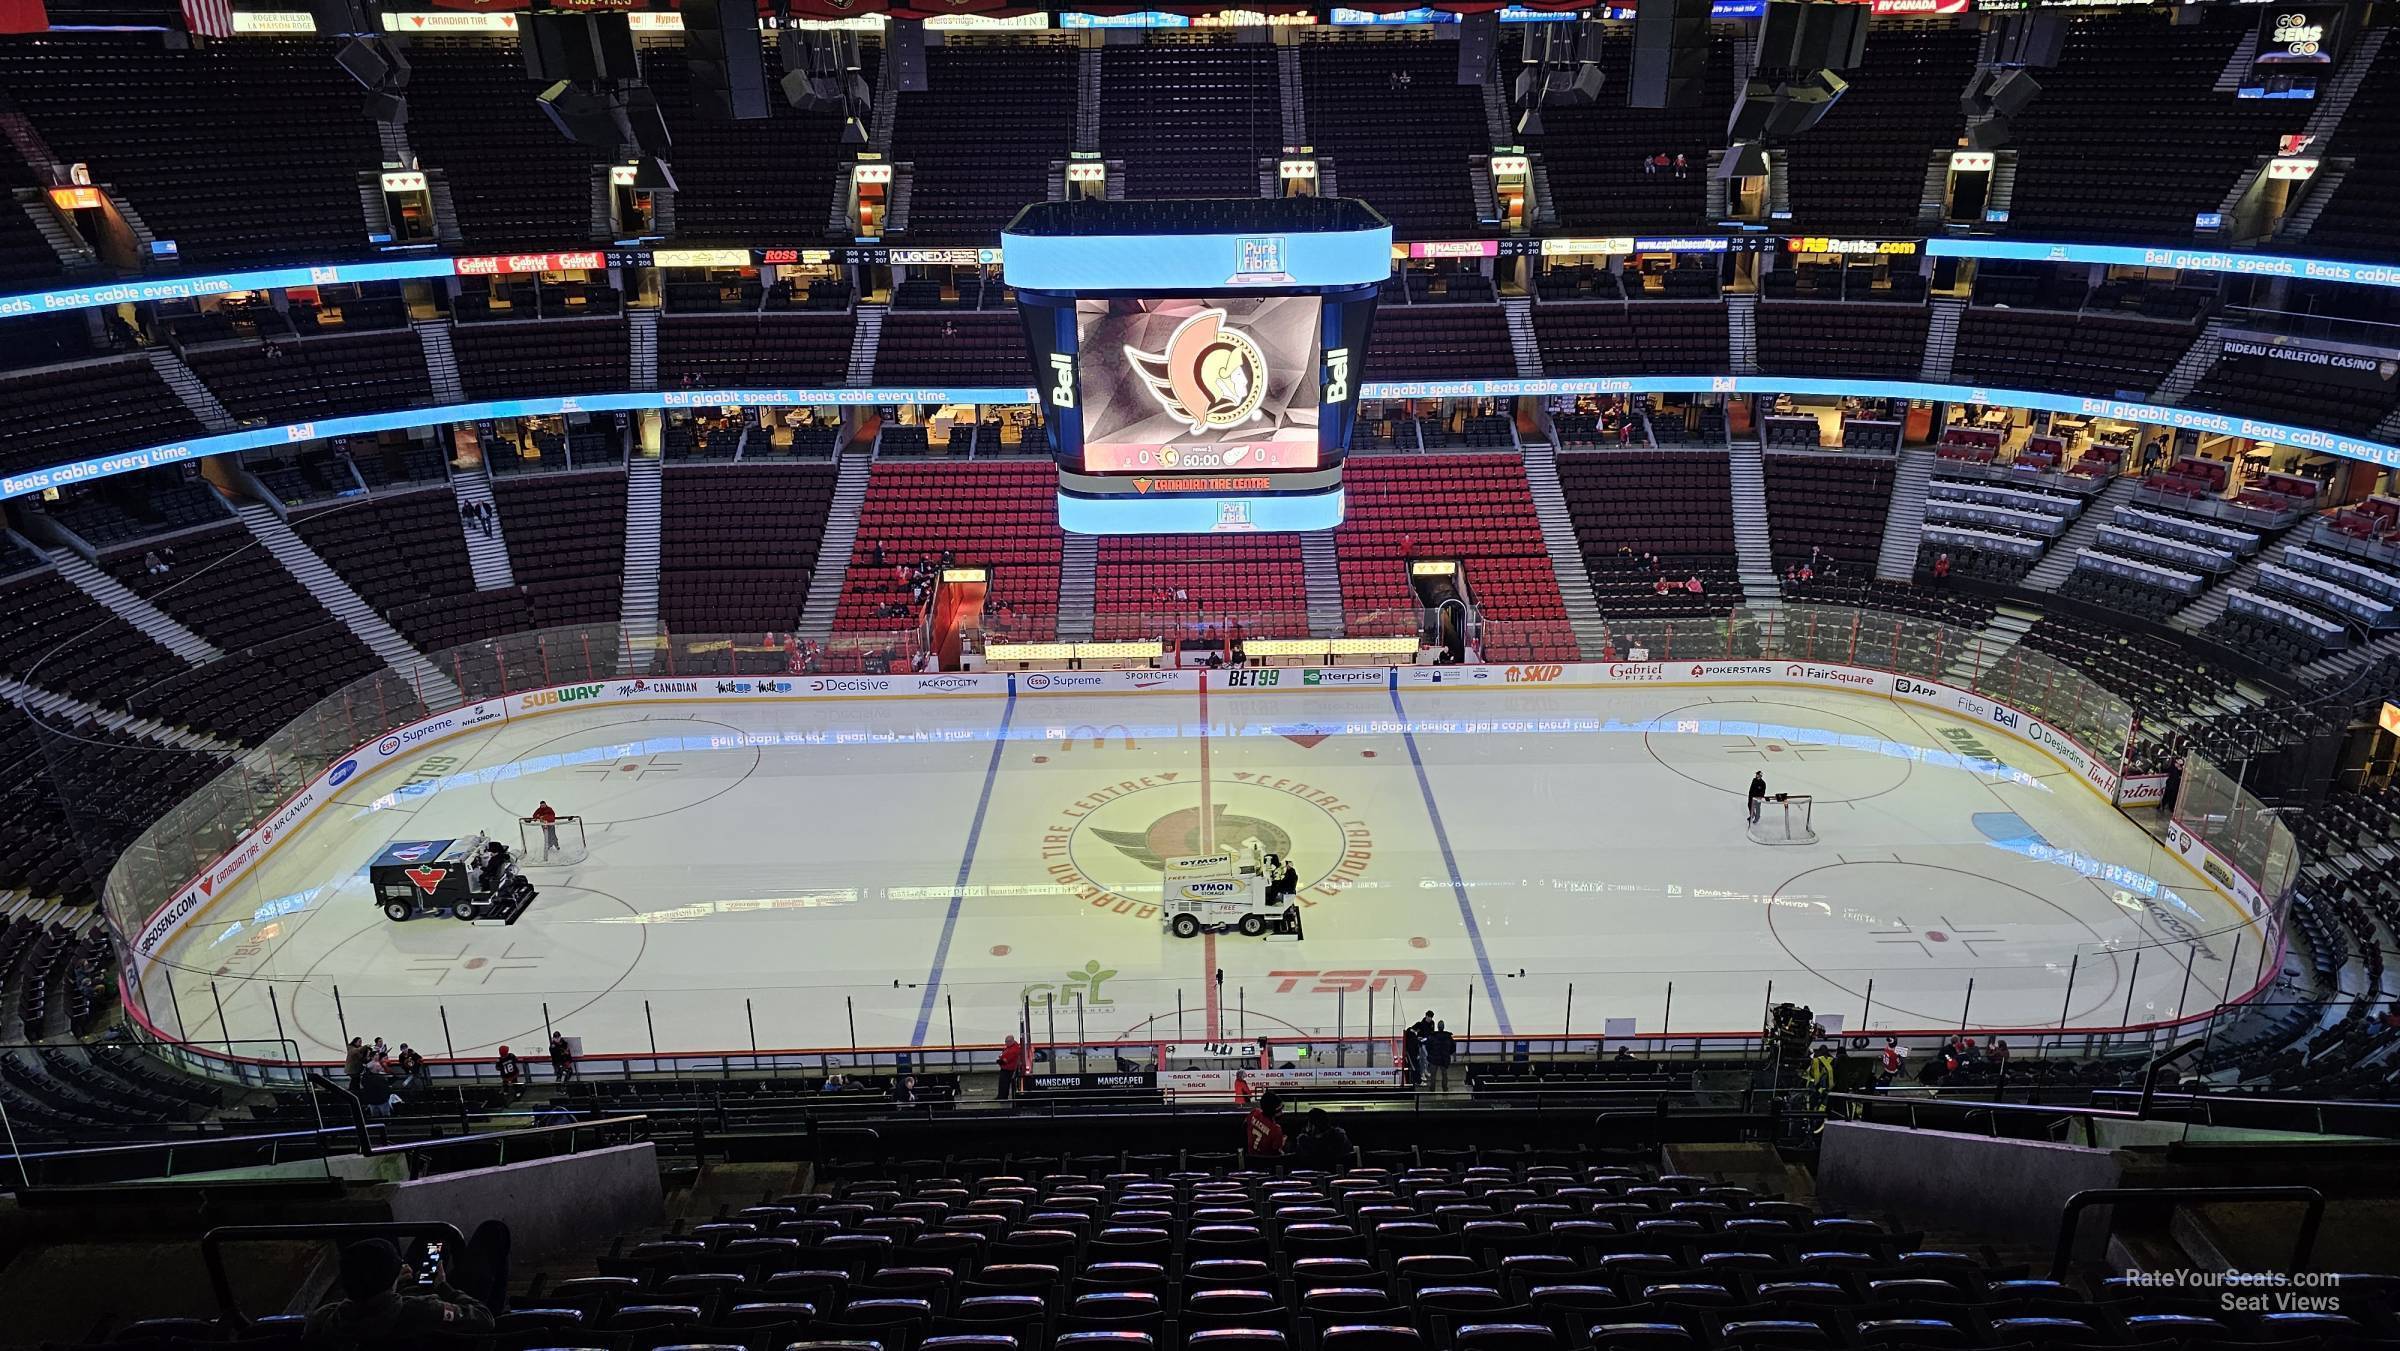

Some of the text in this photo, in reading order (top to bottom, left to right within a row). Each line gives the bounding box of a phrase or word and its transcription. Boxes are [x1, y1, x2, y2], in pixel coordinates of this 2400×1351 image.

[1897, 0, 1937, 10] CANADA
[253, 14, 311, 22] ROGER NEILSON
[259, 22, 290, 30] MAISON
[428, 16, 488, 26] CANADIAN TIRE
[2276, 14, 2306, 29] GO
[2273, 26, 2323, 42] SENS
[2288, 41, 2319, 56] GO
[765, 250, 799, 261] ROSS
[1245, 241, 1277, 255] Pure
[1436, 243, 1483, 253] MAGENTA
[458, 258, 496, 271] Gabriel
[509, 255, 548, 269] Gabriel
[558, 253, 597, 267] Gabriel
[891, 250, 943, 264] ALIGNED
[2145, 250, 2400, 284] Bell gigabit speeds. Beats cable
[311, 267, 338, 284] Bell
[44, 278, 233, 308] Beats cable every time.
[2224, 342, 2377, 371] RIDEAU CARLETON CASINO
[1051, 353, 1074, 409] Bell
[1326, 347, 1348, 405] Bell
[1381, 383, 1426, 398] gigabit
[1430, 382, 1478, 396] speeds.
[1485, 382, 1521, 393] Beats
[1524, 381, 1560, 392] cable
[1561, 381, 1597, 393] every
[1601, 378, 1632, 391] time.
[1712, 377, 1737, 392] Bell
[665, 389, 950, 407] Bell gigabit speeds. Beats cable every time.
[287, 422, 315, 441] Bell
[2082, 399, 2384, 464] Bell gigabit speeds. Beats cable every
[1138, 449, 1150, 465] 0
[1183, 454, 1220, 467] 60:00
[1254, 448, 1266, 462] 0
[3, 445, 192, 494] Beats cable every time.
[1154, 477, 1271, 491] CANADIAN TIRE CENTRE
[1228, 669, 1280, 687] BET99
[1304, 670, 1382, 683] enterprise
[1521, 664, 1564, 682] SKIP
[1609, 663, 1664, 678] Gabriel
[1706, 666, 1772, 674] POKERSTARS
[1807, 668, 1875, 685] FairSquare
[617, 681, 698, 698] Molson CANADIAN
[826, 679, 889, 692] Decisive
[918, 679, 979, 690] JACKPOTCITY
[1053, 676, 1101, 688] Supreme
[521, 684, 605, 710] SUBWAY
[1957, 696, 1984, 715] Fibe
[462, 713, 501, 727] NHLSHOP.CA
[1993, 706, 2019, 729] Bell
[402, 719, 452, 743] Supreme
[2044, 732, 2085, 769] Desjardins
[2087, 760, 2104, 787] Tim
[1062, 776, 1157, 817] CENTRE
[1255, 774, 1350, 815] CENTRE
[273, 793, 314, 832] AIR CANADA
[216, 842, 261, 885] CANADIAN TIRE
[1180, 856, 1228, 866] DYMON
[1042, 823, 1158, 920] ANADIAN TIRE
[1191, 883, 1233, 892] DYMON
[1020, 970, 1118, 1007] GFL
[1267, 969, 1428, 994] TSN
[1035, 1077, 1081, 1087] MANSCAPED
[1097, 1076, 1144, 1085] MANSCAPED
[1252, 1127, 1263, 1150] 7
